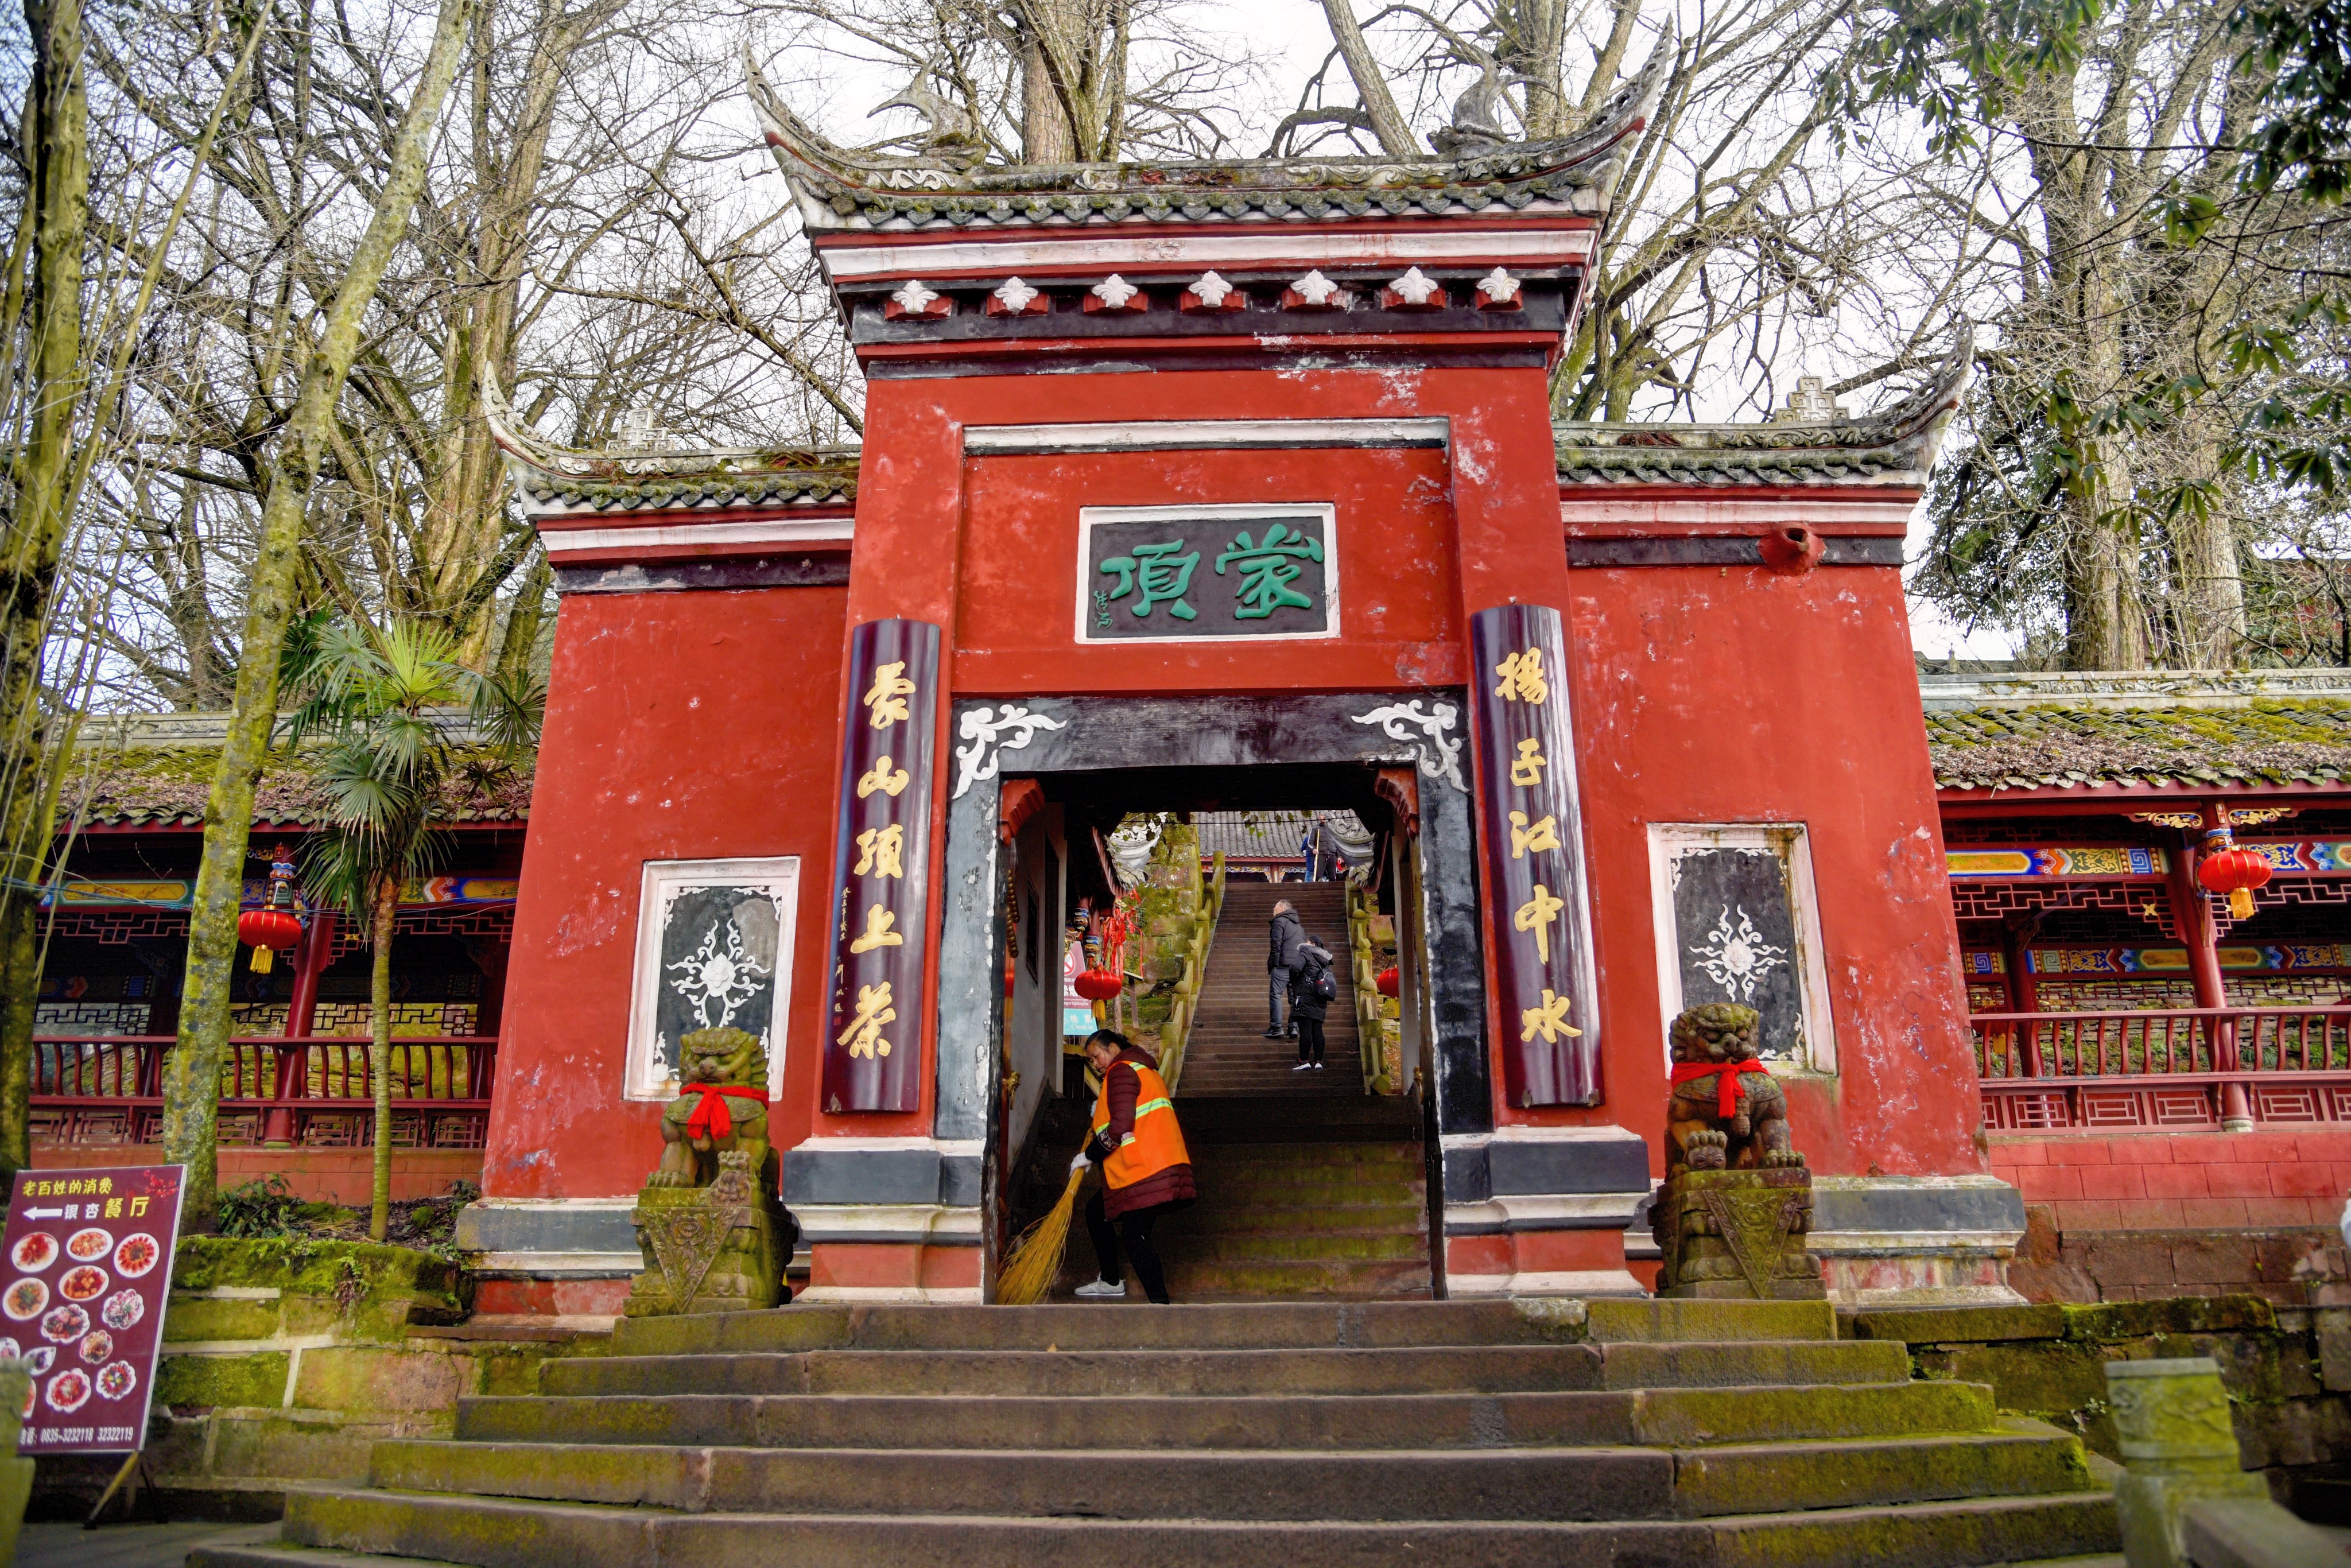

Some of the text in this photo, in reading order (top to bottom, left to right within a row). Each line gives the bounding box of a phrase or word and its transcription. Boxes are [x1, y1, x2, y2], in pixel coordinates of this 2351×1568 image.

[22, 1177, 112, 1197] 老百姓的消费
[64, 1196, 150, 1220] 银杏餐厅
[98, 1427, 134, 1442] 32322119
